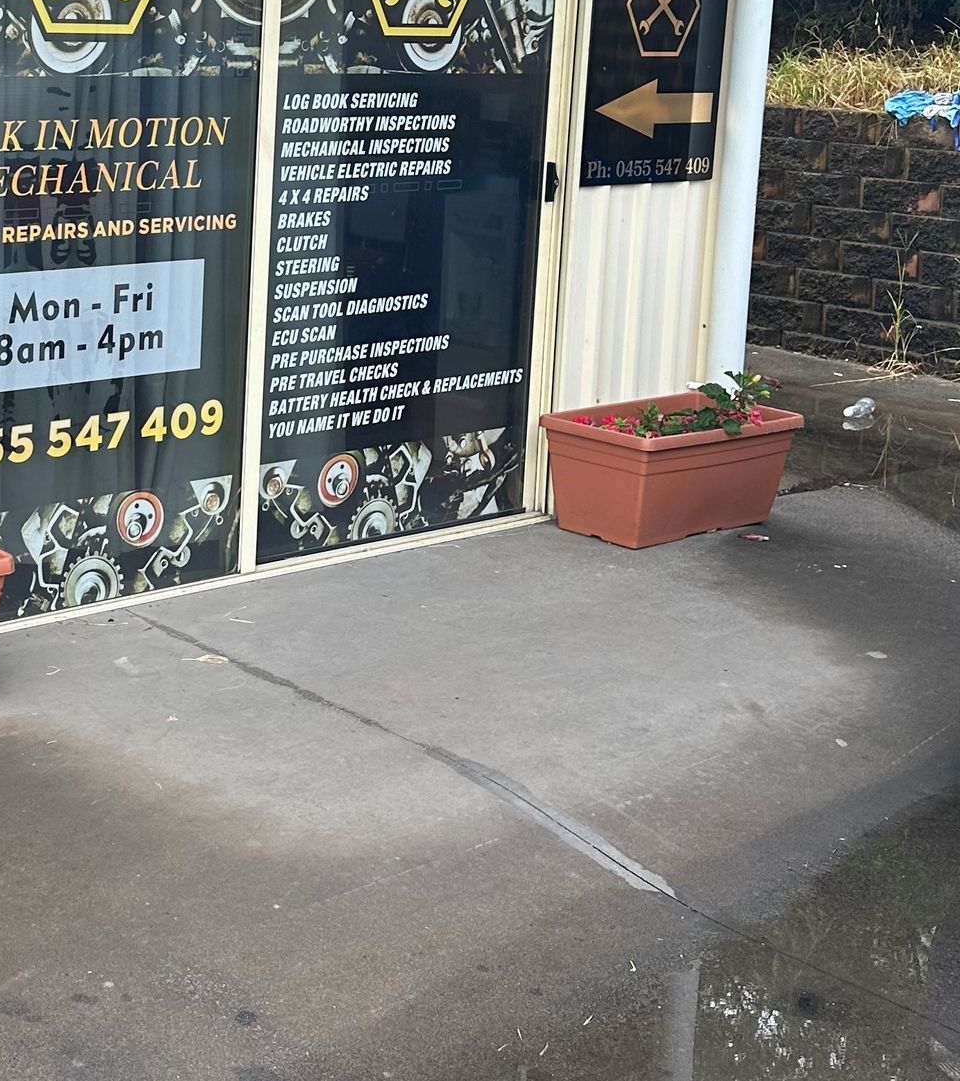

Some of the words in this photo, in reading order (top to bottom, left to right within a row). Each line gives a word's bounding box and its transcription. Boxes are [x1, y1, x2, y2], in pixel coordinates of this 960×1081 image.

[283, 94, 310, 110] LOG
[312, 93, 347, 109] BOOK
[351, 92, 418, 108] SERVICING
[34, 119, 78, 150] IN
[86, 116, 230, 149] MOTION
[282, 116, 374, 134] ROADWORTHY
[375, 115, 456, 132] INSPECTIONS
[281, 140, 366, 158] MECHANICAL
[368, 137, 450, 154] INSPECTIONS
[280, 164, 334, 181] VEHICLE
[337, 162, 397, 179] ELECTRIC
[399, 160, 451, 176] REPAIRS
[586, 161, 611, 178] Ph:
[616, 160, 652, 177] 0455
[655, 158, 682, 176] 547
[685, 157, 710, 174] 409
[279, 190, 287, 206] 4
[290, 190, 299, 205] X
[302, 189, 310, 204] 4
[313, 186, 369, 203] REPAIRS
[2, 222, 88, 243] REPAIRS
[93, 220, 134, 236] AND
[138, 214, 237, 234] SERVICING
[277, 210, 331, 230] BRAKES
[276, 234, 328, 253] CLUTCH
[275, 256, 340, 276] STEERING
[274, 278, 358, 300] SUSPENSION
[9, 291, 80, 324] Mon
[113, 282, 153, 314] Fri
[273, 305, 308, 324] SCAN
[313, 302, 343, 319] TOOL
[346, 293, 428, 316] DIAGNOSTICS
[97, 324, 163, 360] 4pm
[272, 329, 299, 346] ECU
[300, 325, 336, 343] SCAN
[271, 353, 297, 370] PRE
[299, 344, 367, 366] PURCHASE
[370, 335, 450, 358] INSPECTIONS
[270, 376, 297, 393] PRE
[299, 370, 346, 389] TRAVEL
[349, 363, 399, 383] CHECKS
[269, 394, 328, 416] BATTERY
[330, 388, 377, 408] HEALTH
[380, 381, 420, 401] CHECK
[422, 381, 430, 394] &
[433, 369, 523, 393] REPLACEMENTS
[47, 412, 130, 458] 547
[141, 399, 224, 442] 409
[268, 422, 294, 439] YOU
[297, 415, 334, 435] NAME
[337, 414, 350, 430] IT
[352, 411, 370, 426] WE
[373, 408, 390, 424] DO
[392, 405, 406, 420] IT
